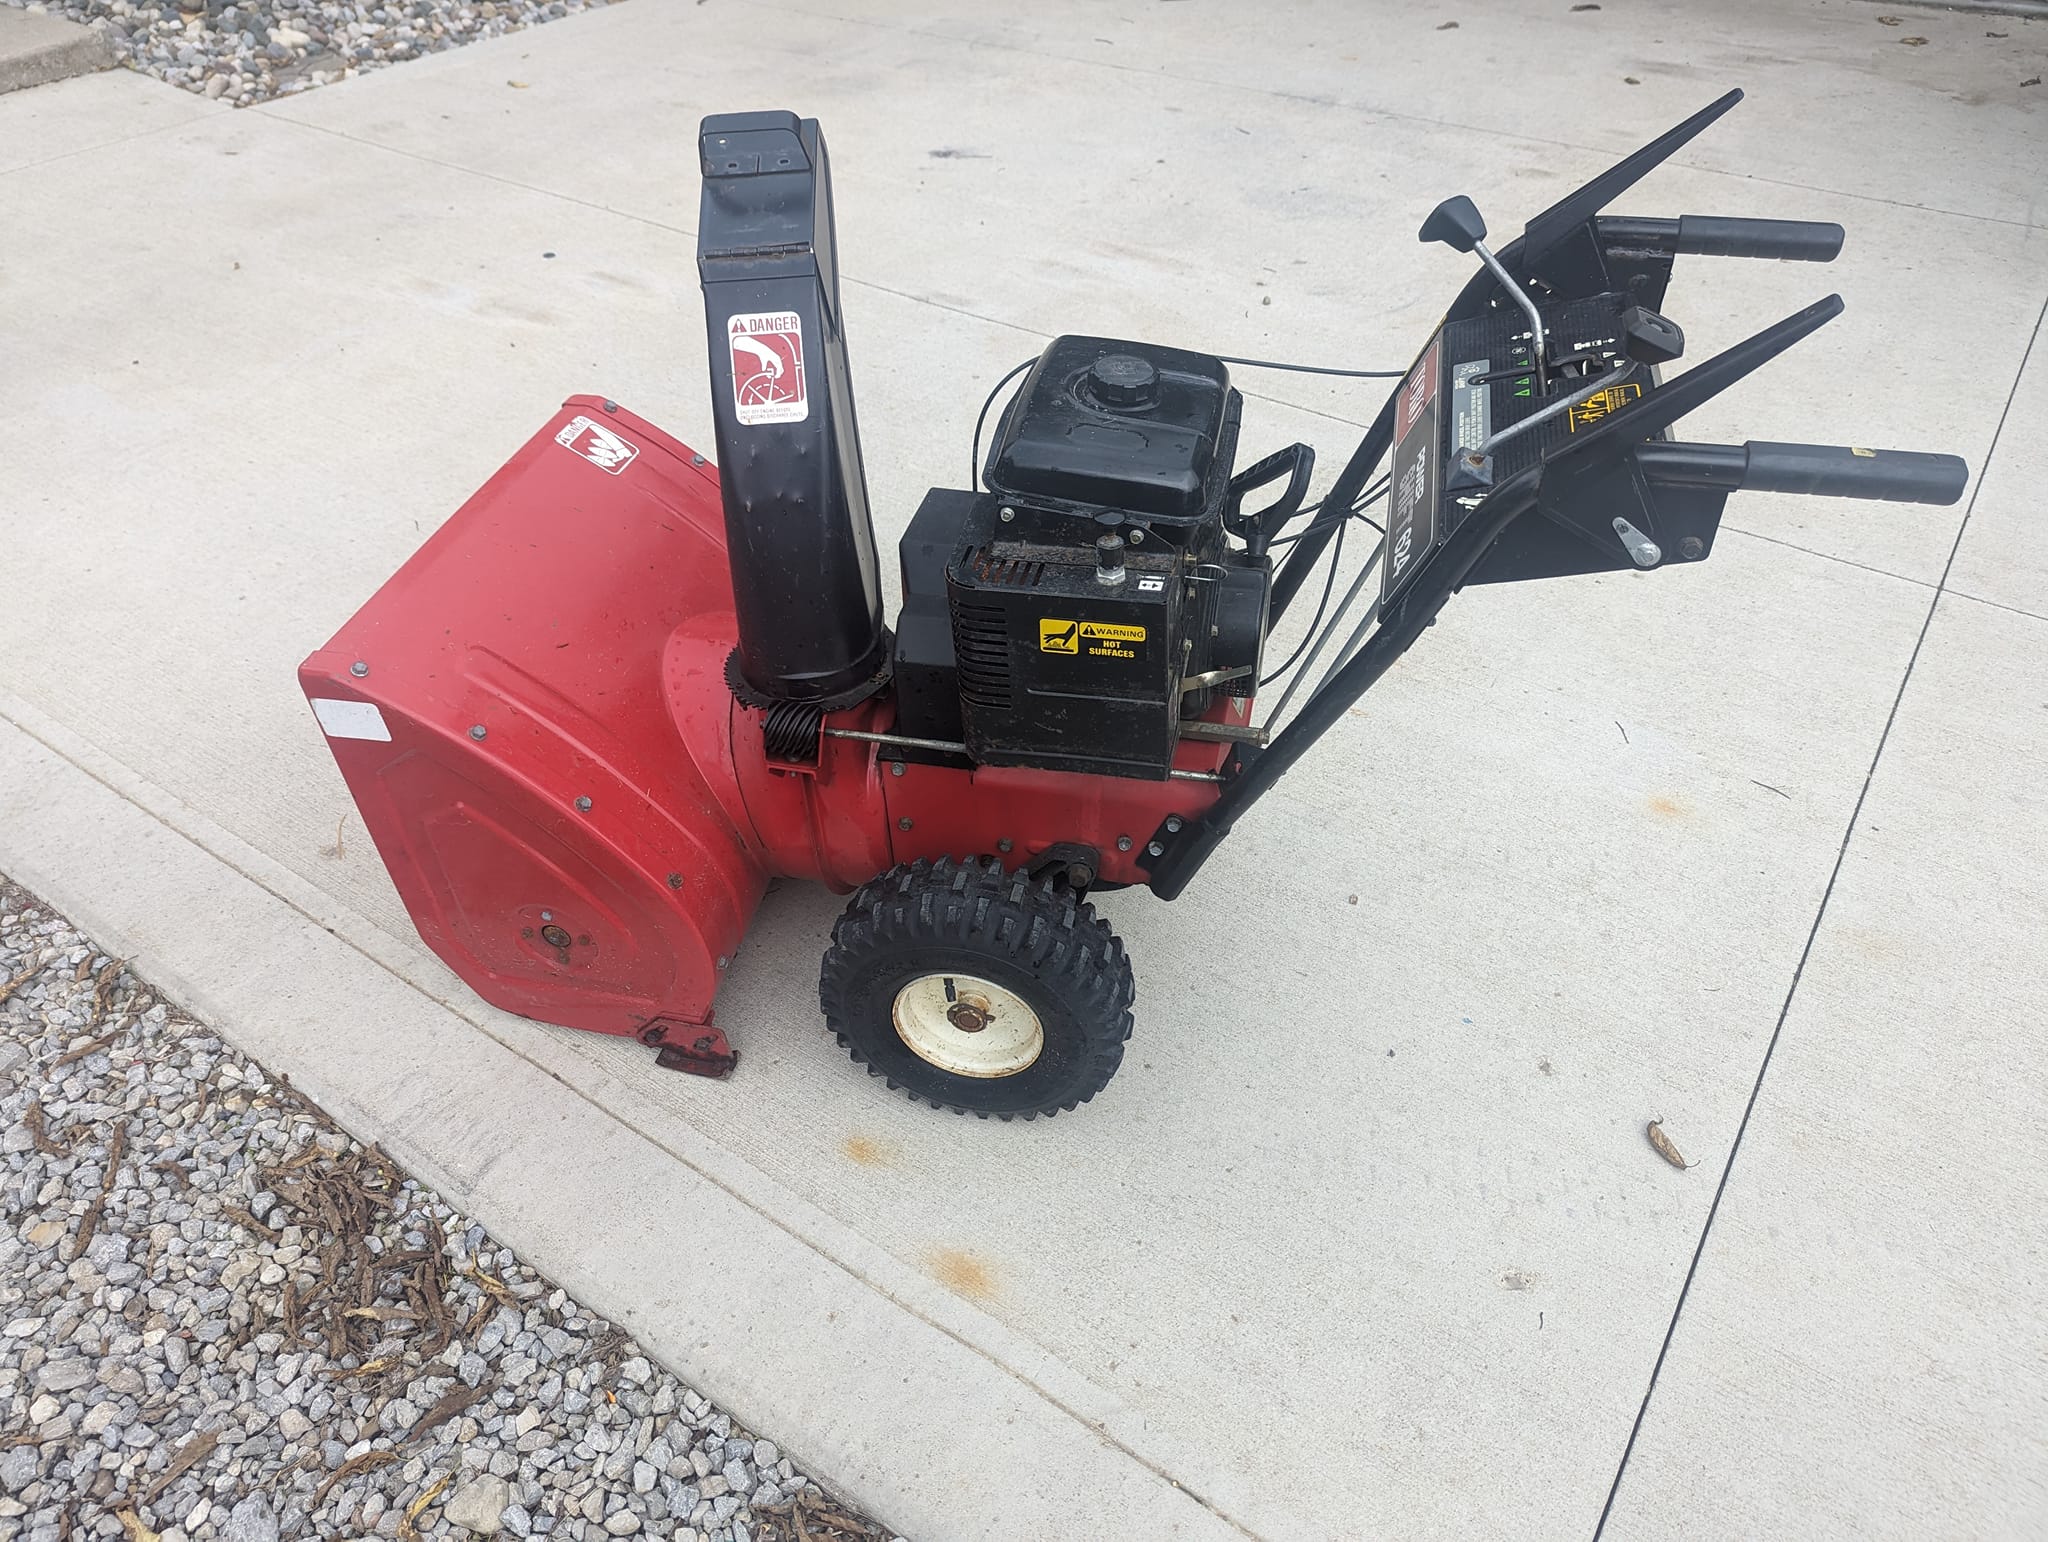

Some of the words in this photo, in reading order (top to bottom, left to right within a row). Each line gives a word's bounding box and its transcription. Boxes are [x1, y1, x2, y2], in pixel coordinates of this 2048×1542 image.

[749, 316, 798, 333] DANGER
[1407, 361, 1426, 424] TORO
[564, 417, 590, 439] DANGER
[1414, 445, 1426, 505] POWER
[1392, 527, 1412, 579] 624
[1096, 627, 1144, 639] WARNING
[1088, 647, 1135, 658] SURFACES
[1103, 640, 1121, 649] HOT
